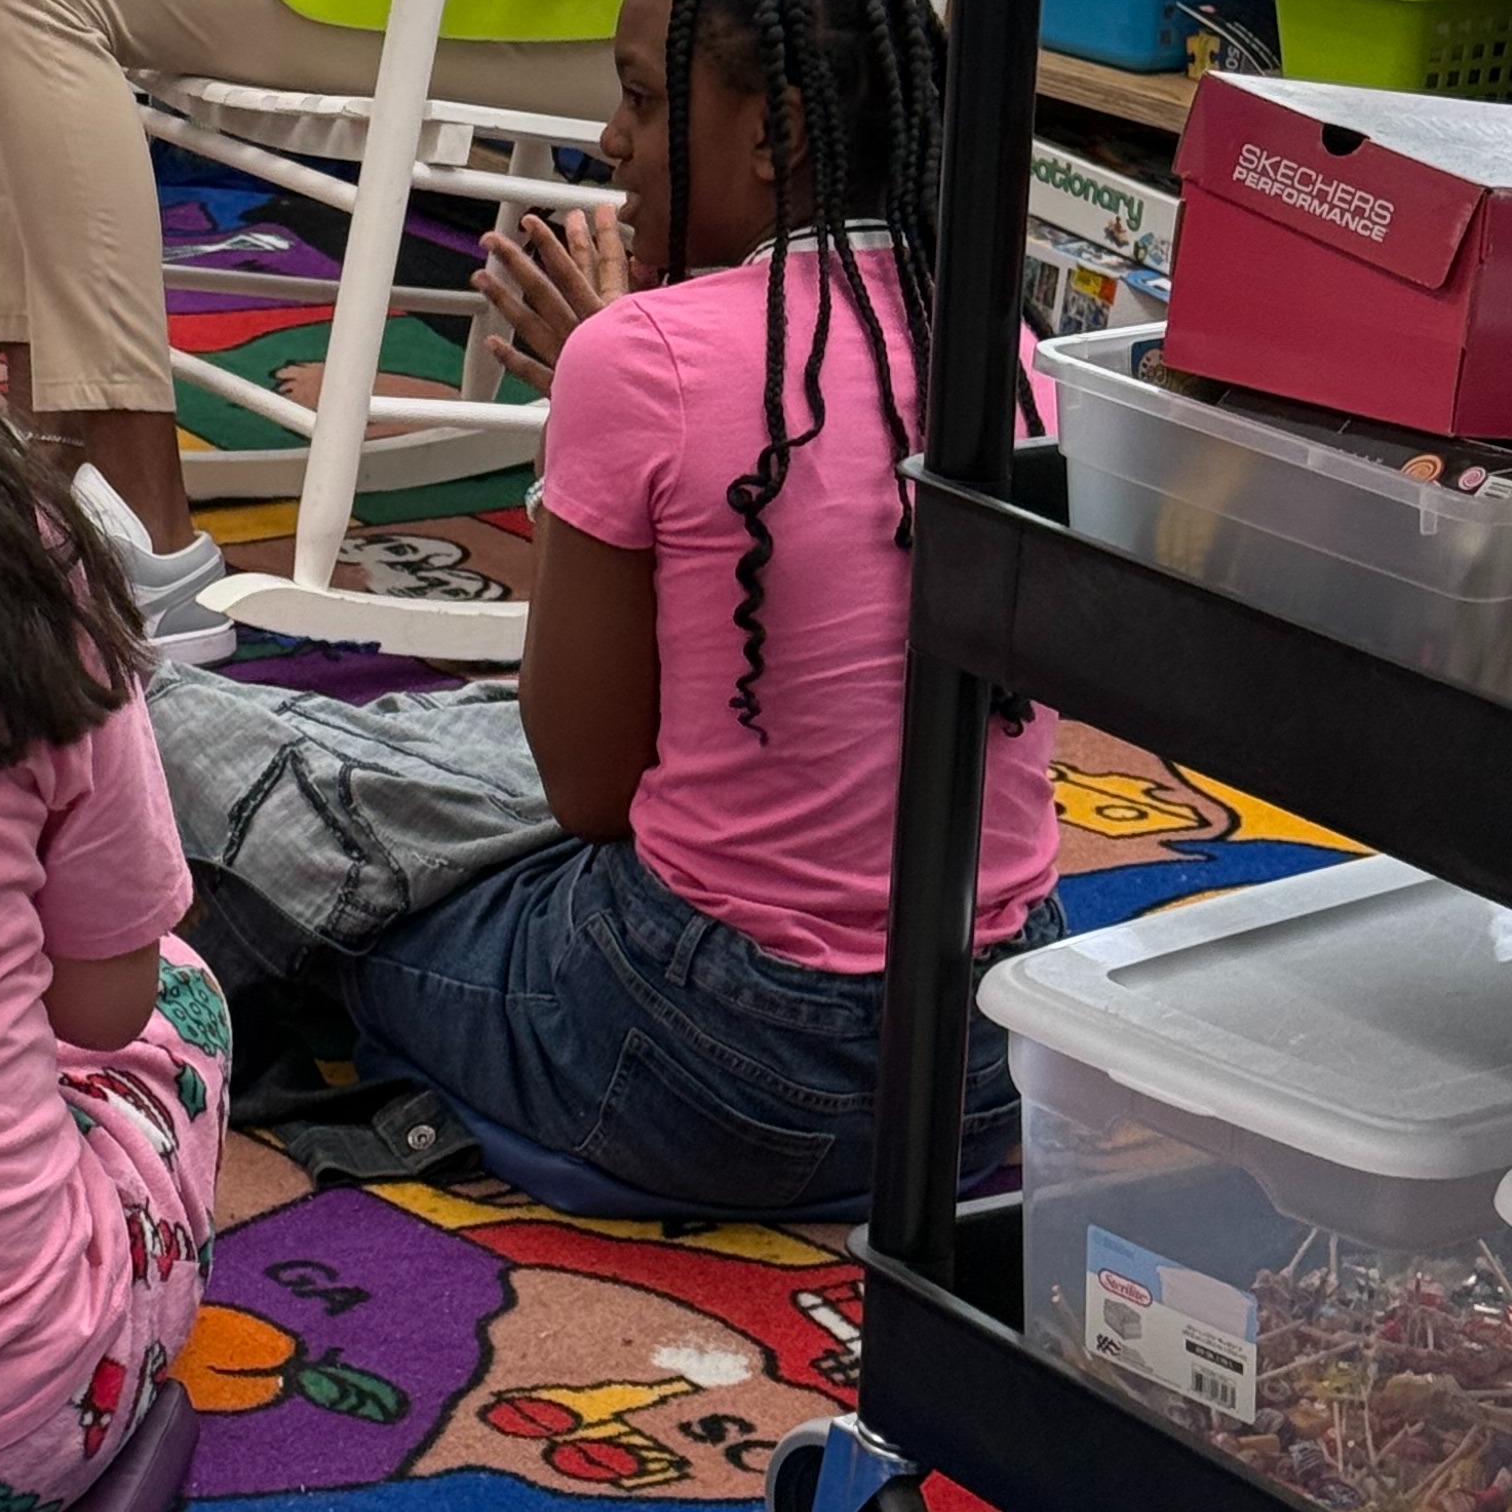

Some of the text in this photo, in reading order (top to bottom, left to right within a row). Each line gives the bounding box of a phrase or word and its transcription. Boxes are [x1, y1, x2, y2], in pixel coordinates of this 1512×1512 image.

[1031, 156, 1144, 231] ationary
[1232, 165, 1388, 243] PERFORMANCE
[1238, 143, 1395, 226] SKECHERS
[264, 1259, 373, 1317] GA
